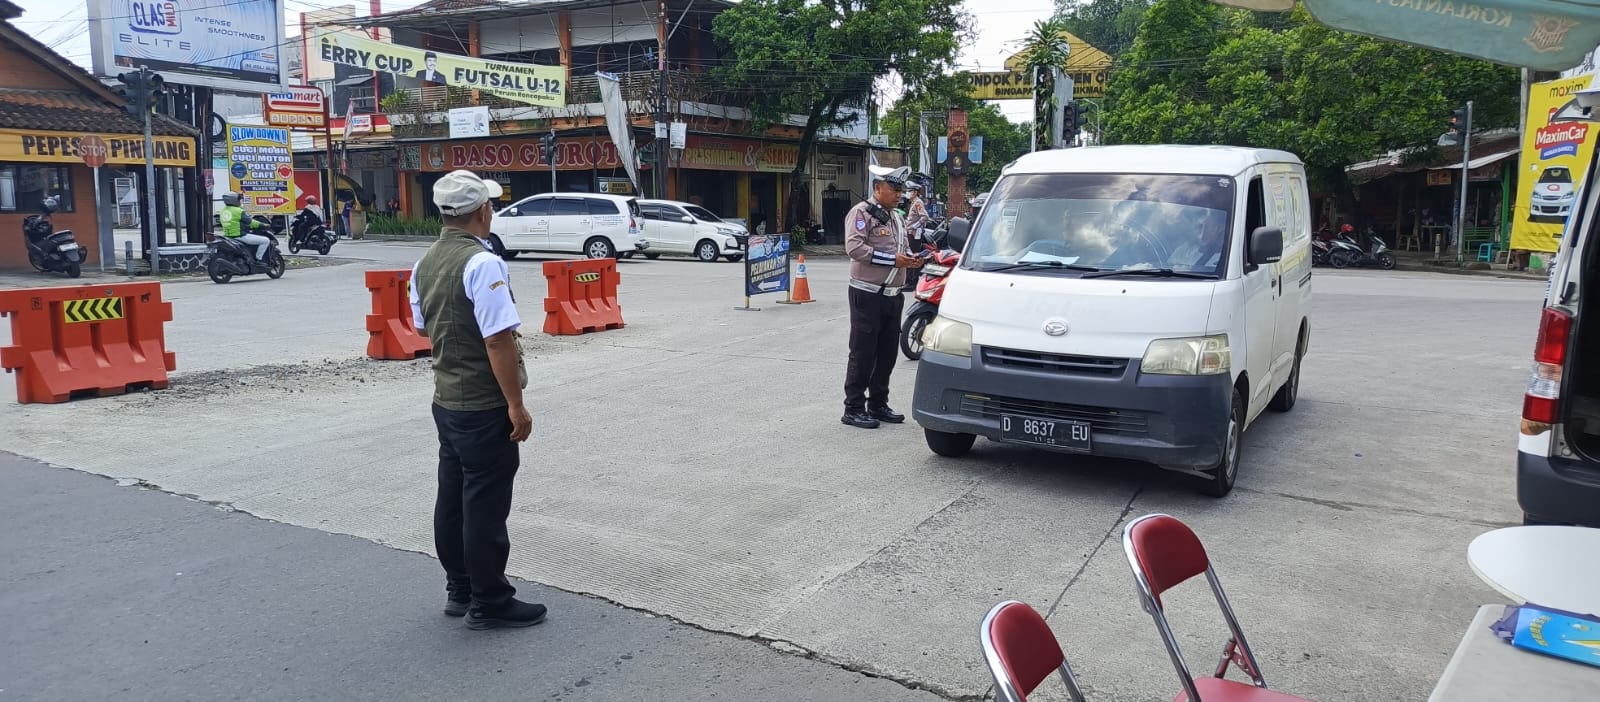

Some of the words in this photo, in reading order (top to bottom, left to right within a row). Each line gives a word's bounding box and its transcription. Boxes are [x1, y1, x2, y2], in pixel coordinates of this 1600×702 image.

[133, 1, 165, 27] CLAS
[164, 3, 177, 27] MILD
[195, 16, 232, 27] INTENSE
[119, 33, 192, 50] ELITE
[208, 27, 266, 41] SMOOTHNESS
[375, 54, 413, 73] CUP
[485, 62, 535, 75] TURNAMEN
[454, 67, 524, 90] FUTSAL
[527, 76, 561, 94] U-12
[967, 73, 1011, 86] ONDOK
[1549, 81, 1585, 98] maxim
[231, 127, 255, 143] SLOW
[256, 127, 280, 142] DOWN
[1536, 126, 1586, 146] MaximCar
[21, 135, 82, 157] PEPES
[80, 144, 106, 158] STOP
[233, 146, 257, 154] CUCI
[258, 146, 288, 154] MOBIL
[231, 154, 255, 162] CUCI
[257, 155, 291, 163] MOTOR
[452, 143, 514, 168] BASO
[744, 144, 758, 167] &
[247, 163, 277, 171] POLES
[251, 171, 275, 179] CAFE
[1003, 417, 1011, 432] D
[1024, 419, 1055, 437] 8637
[1072, 424, 1088, 441] EU
